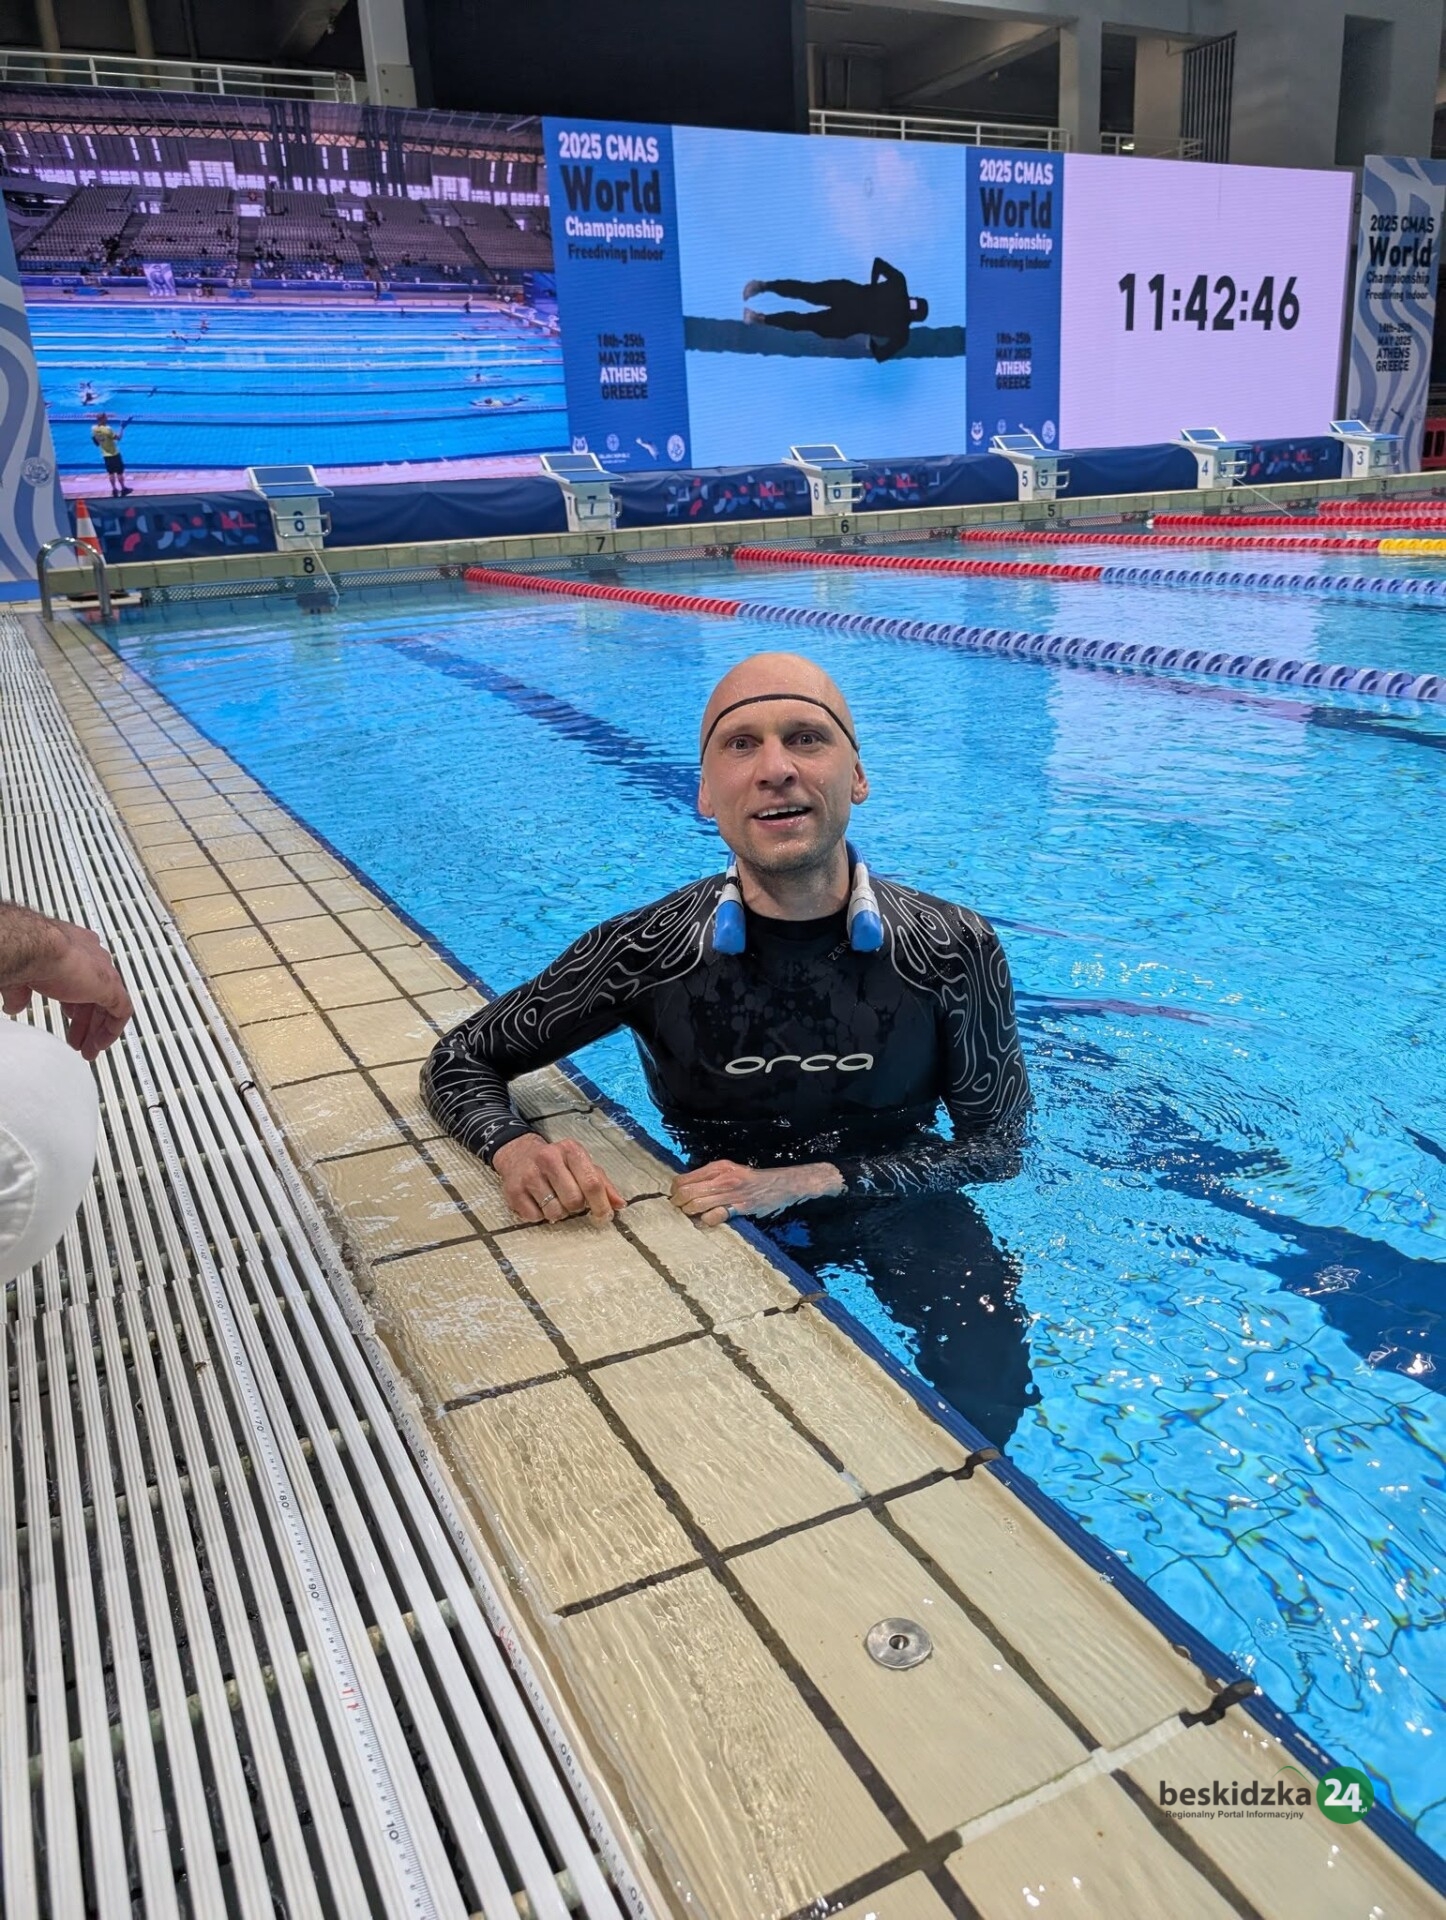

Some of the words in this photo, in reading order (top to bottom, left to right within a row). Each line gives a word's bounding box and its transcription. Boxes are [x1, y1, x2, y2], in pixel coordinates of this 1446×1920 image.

[558, 131, 603, 160] 2025
[605, 134, 660, 163] CMAS
[979, 158, 1012, 183] 2025
[1014, 160, 1054, 186] CMAS
[559, 164, 662, 214] World
[979, 186, 1053, 229] World
[565, 215, 664, 244] Championship
[1370, 214, 1398, 232] 2025
[1400, 215, 1435, 234] CMAS
[979, 230, 1053, 255] Championship
[567, 243, 628, 264] Freediving
[630, 244, 665, 261] Indoor
[1369, 236, 1433, 268] World
[1366, 270, 1430, 287] Championship
[1118, 273, 1300, 331] 11:42:46
[598, 351, 621, 365] MAY
[622, 350, 646, 365] 2025
[1376, 347, 1411, 359] ATHENS
[600, 366, 648, 383] ATHENS
[995, 361, 1032, 376] ATHENS
[1375, 360, 1410, 372] GREECE
[996, 376, 1032, 390] GREECE
[601, 384, 649, 400] GREECE
[1356, 450, 1364, 466] 3
[1201, 460, 1209, 476] 4
[1021, 470, 1029, 487] 5
[1040, 469, 1049, 486] 5
[813, 483, 820, 501] 6
[833, 481, 842, 499] 6
[1047, 504, 1056, 518] 5
[840, 519, 850, 534] 6
[595, 536, 606, 553] 7
[303, 556, 315, 574] 8
[724, 1053, 874, 1075] orca
[387, 1380, 396, 1393] 30
[419, 1449, 429, 1464] 20
[216, 1298, 224, 1310] 50
[234, 1355, 243, 1366] 60
[255, 1420, 264, 1432] 70
[279, 1494, 290, 1508] 80
[308, 1583, 320, 1599] 90
[386, 1820, 400, 1841] 10
[560, 1743, 572, 1766] 90
